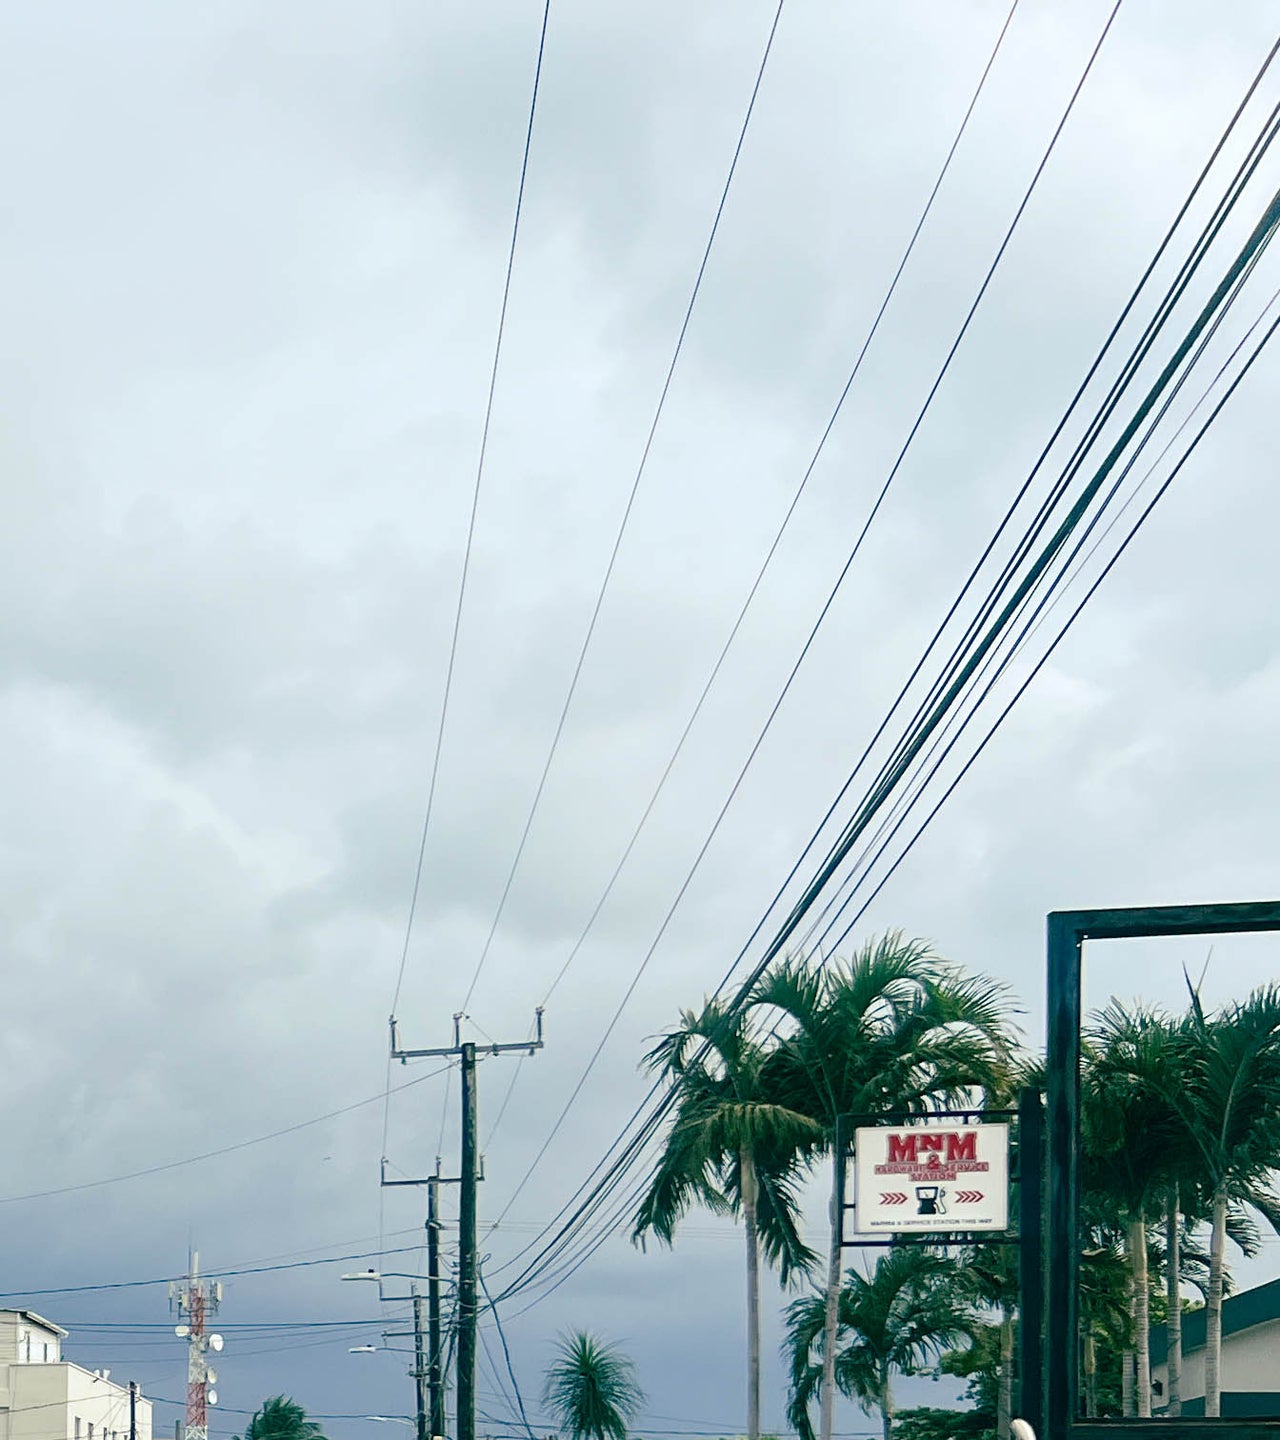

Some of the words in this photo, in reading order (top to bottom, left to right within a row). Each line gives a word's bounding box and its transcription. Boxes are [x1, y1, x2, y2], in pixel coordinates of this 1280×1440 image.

[887, 1132, 977, 1164] MNM
[944, 1162, 989, 1172] SERVICE
[910, 1173, 956, 1181] STATION
